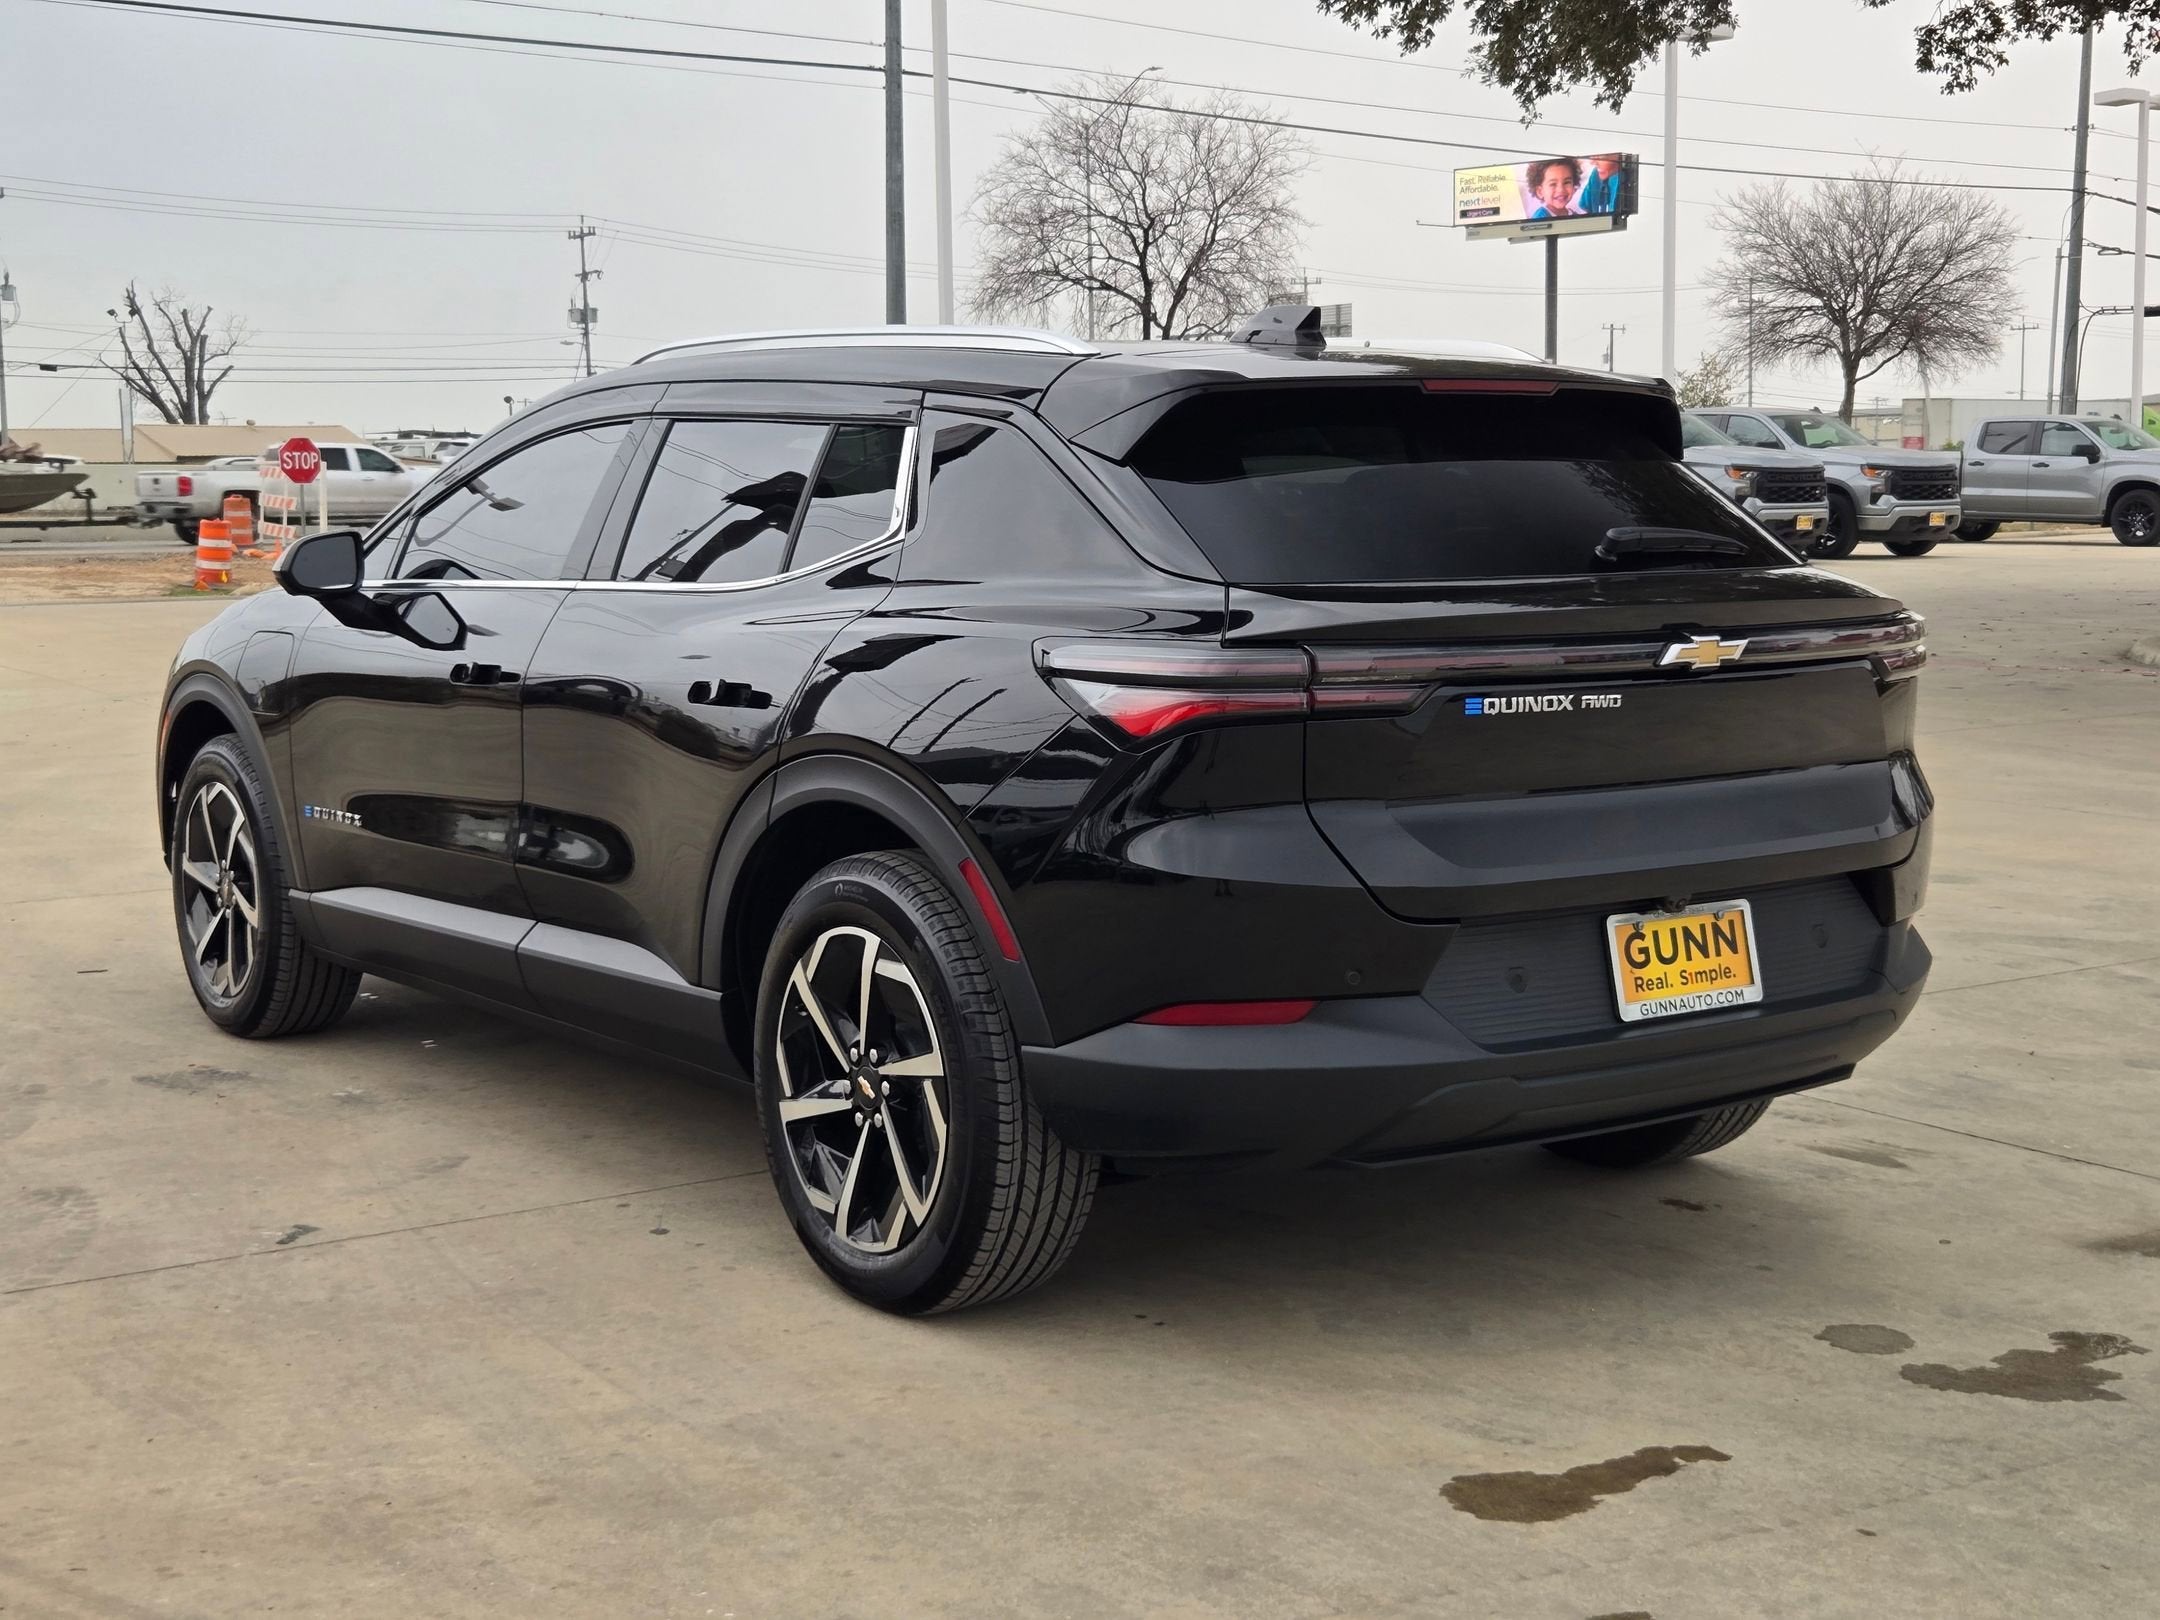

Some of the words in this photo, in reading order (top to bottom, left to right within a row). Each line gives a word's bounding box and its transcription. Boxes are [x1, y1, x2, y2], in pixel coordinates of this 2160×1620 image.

[1459, 197, 1480, 207] next
[1482, 195, 1500, 205] level
[283, 452, 319, 470] STOP
[1465, 694, 1574, 715] EQUINOX
[1581, 694, 1622, 709] AWD
[304, 805, 362, 827] EQUINOX
[1624, 919, 1738, 969] GUNN
[1634, 972, 1674, 993] Real.
[1640, 989, 1745, 1017] GUNNAUTO.COM
